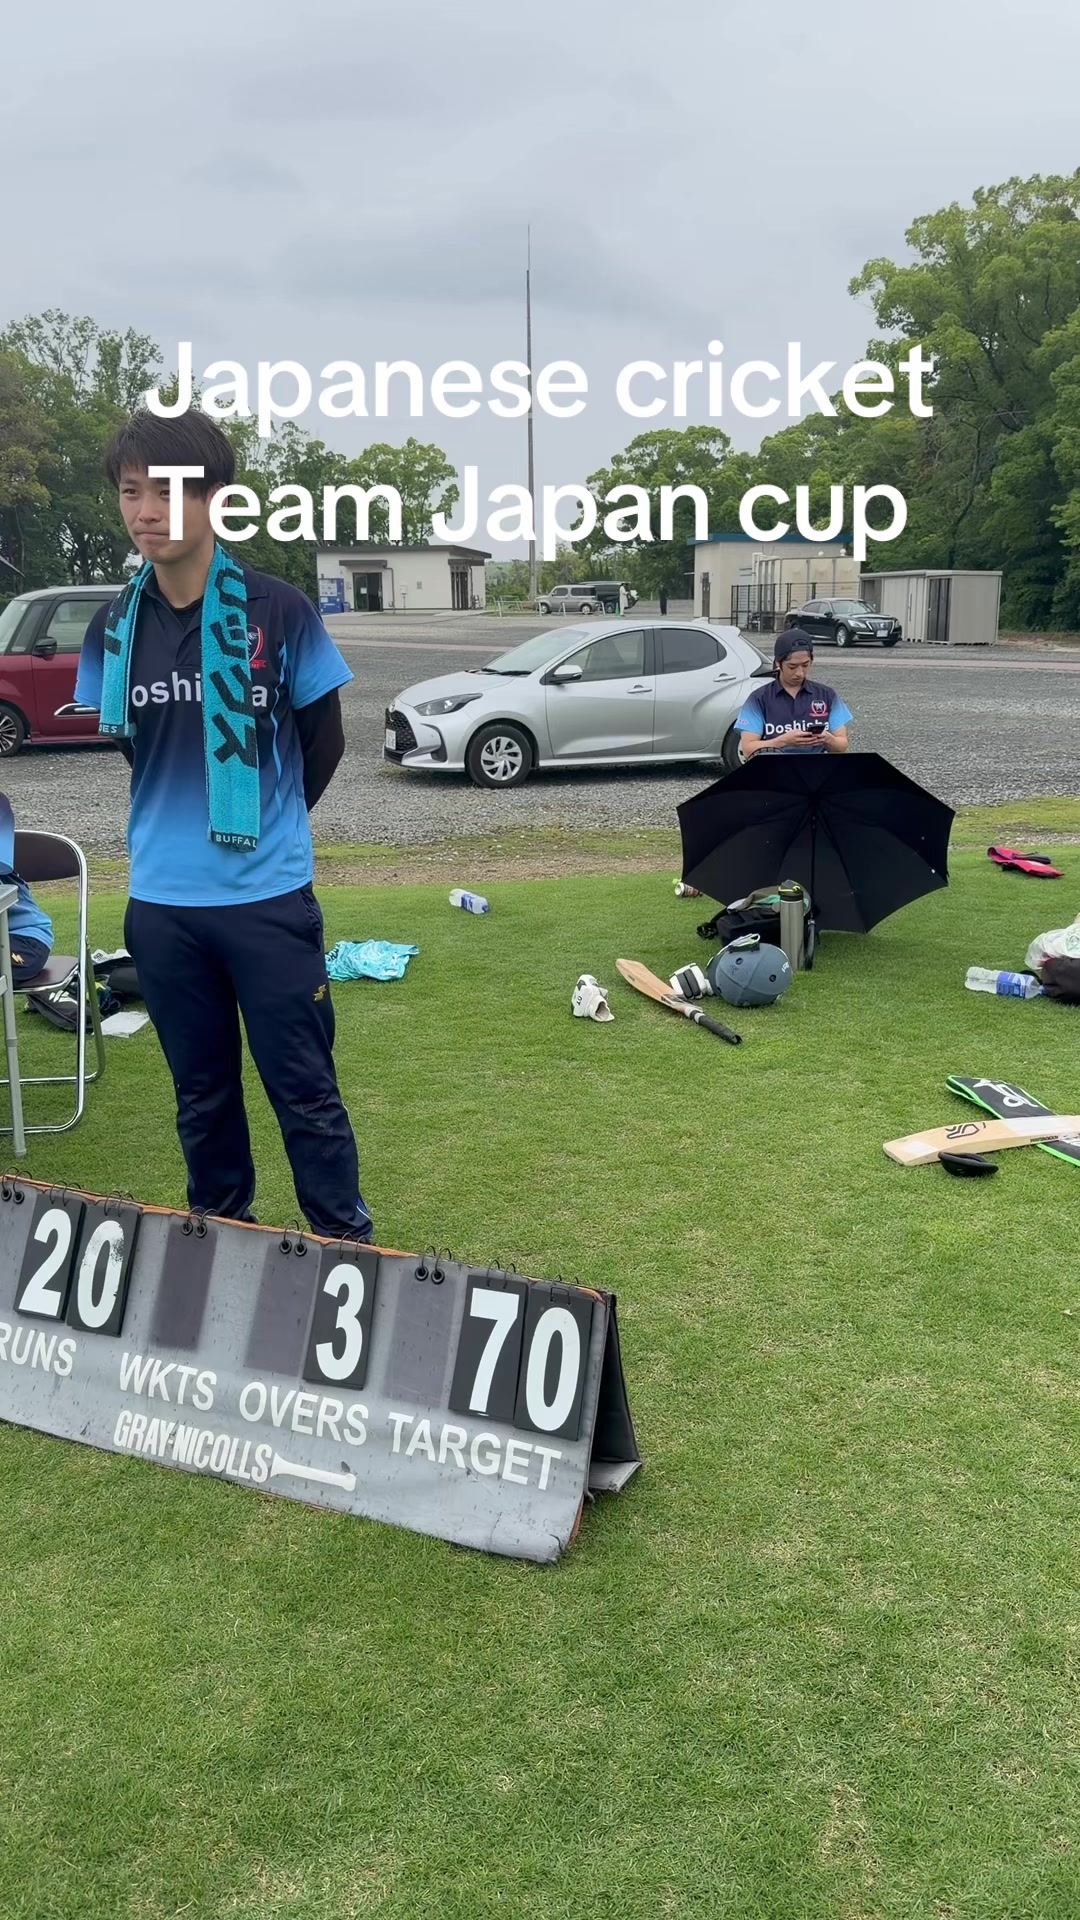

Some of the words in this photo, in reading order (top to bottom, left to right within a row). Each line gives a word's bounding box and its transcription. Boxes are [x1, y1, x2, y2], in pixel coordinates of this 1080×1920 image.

[131, 671, 268, 708] oshia
[315, 1263, 365, 1380] 3
[0, 1321, 77, 1377] RUNS
[119, 1352, 218, 1411] WKTS
[239, 1381, 369, 1446] OVERS
[387, 1411, 562, 1491] TARGET
[113, 1410, 273, 1483] GRAY-NICOLLS
